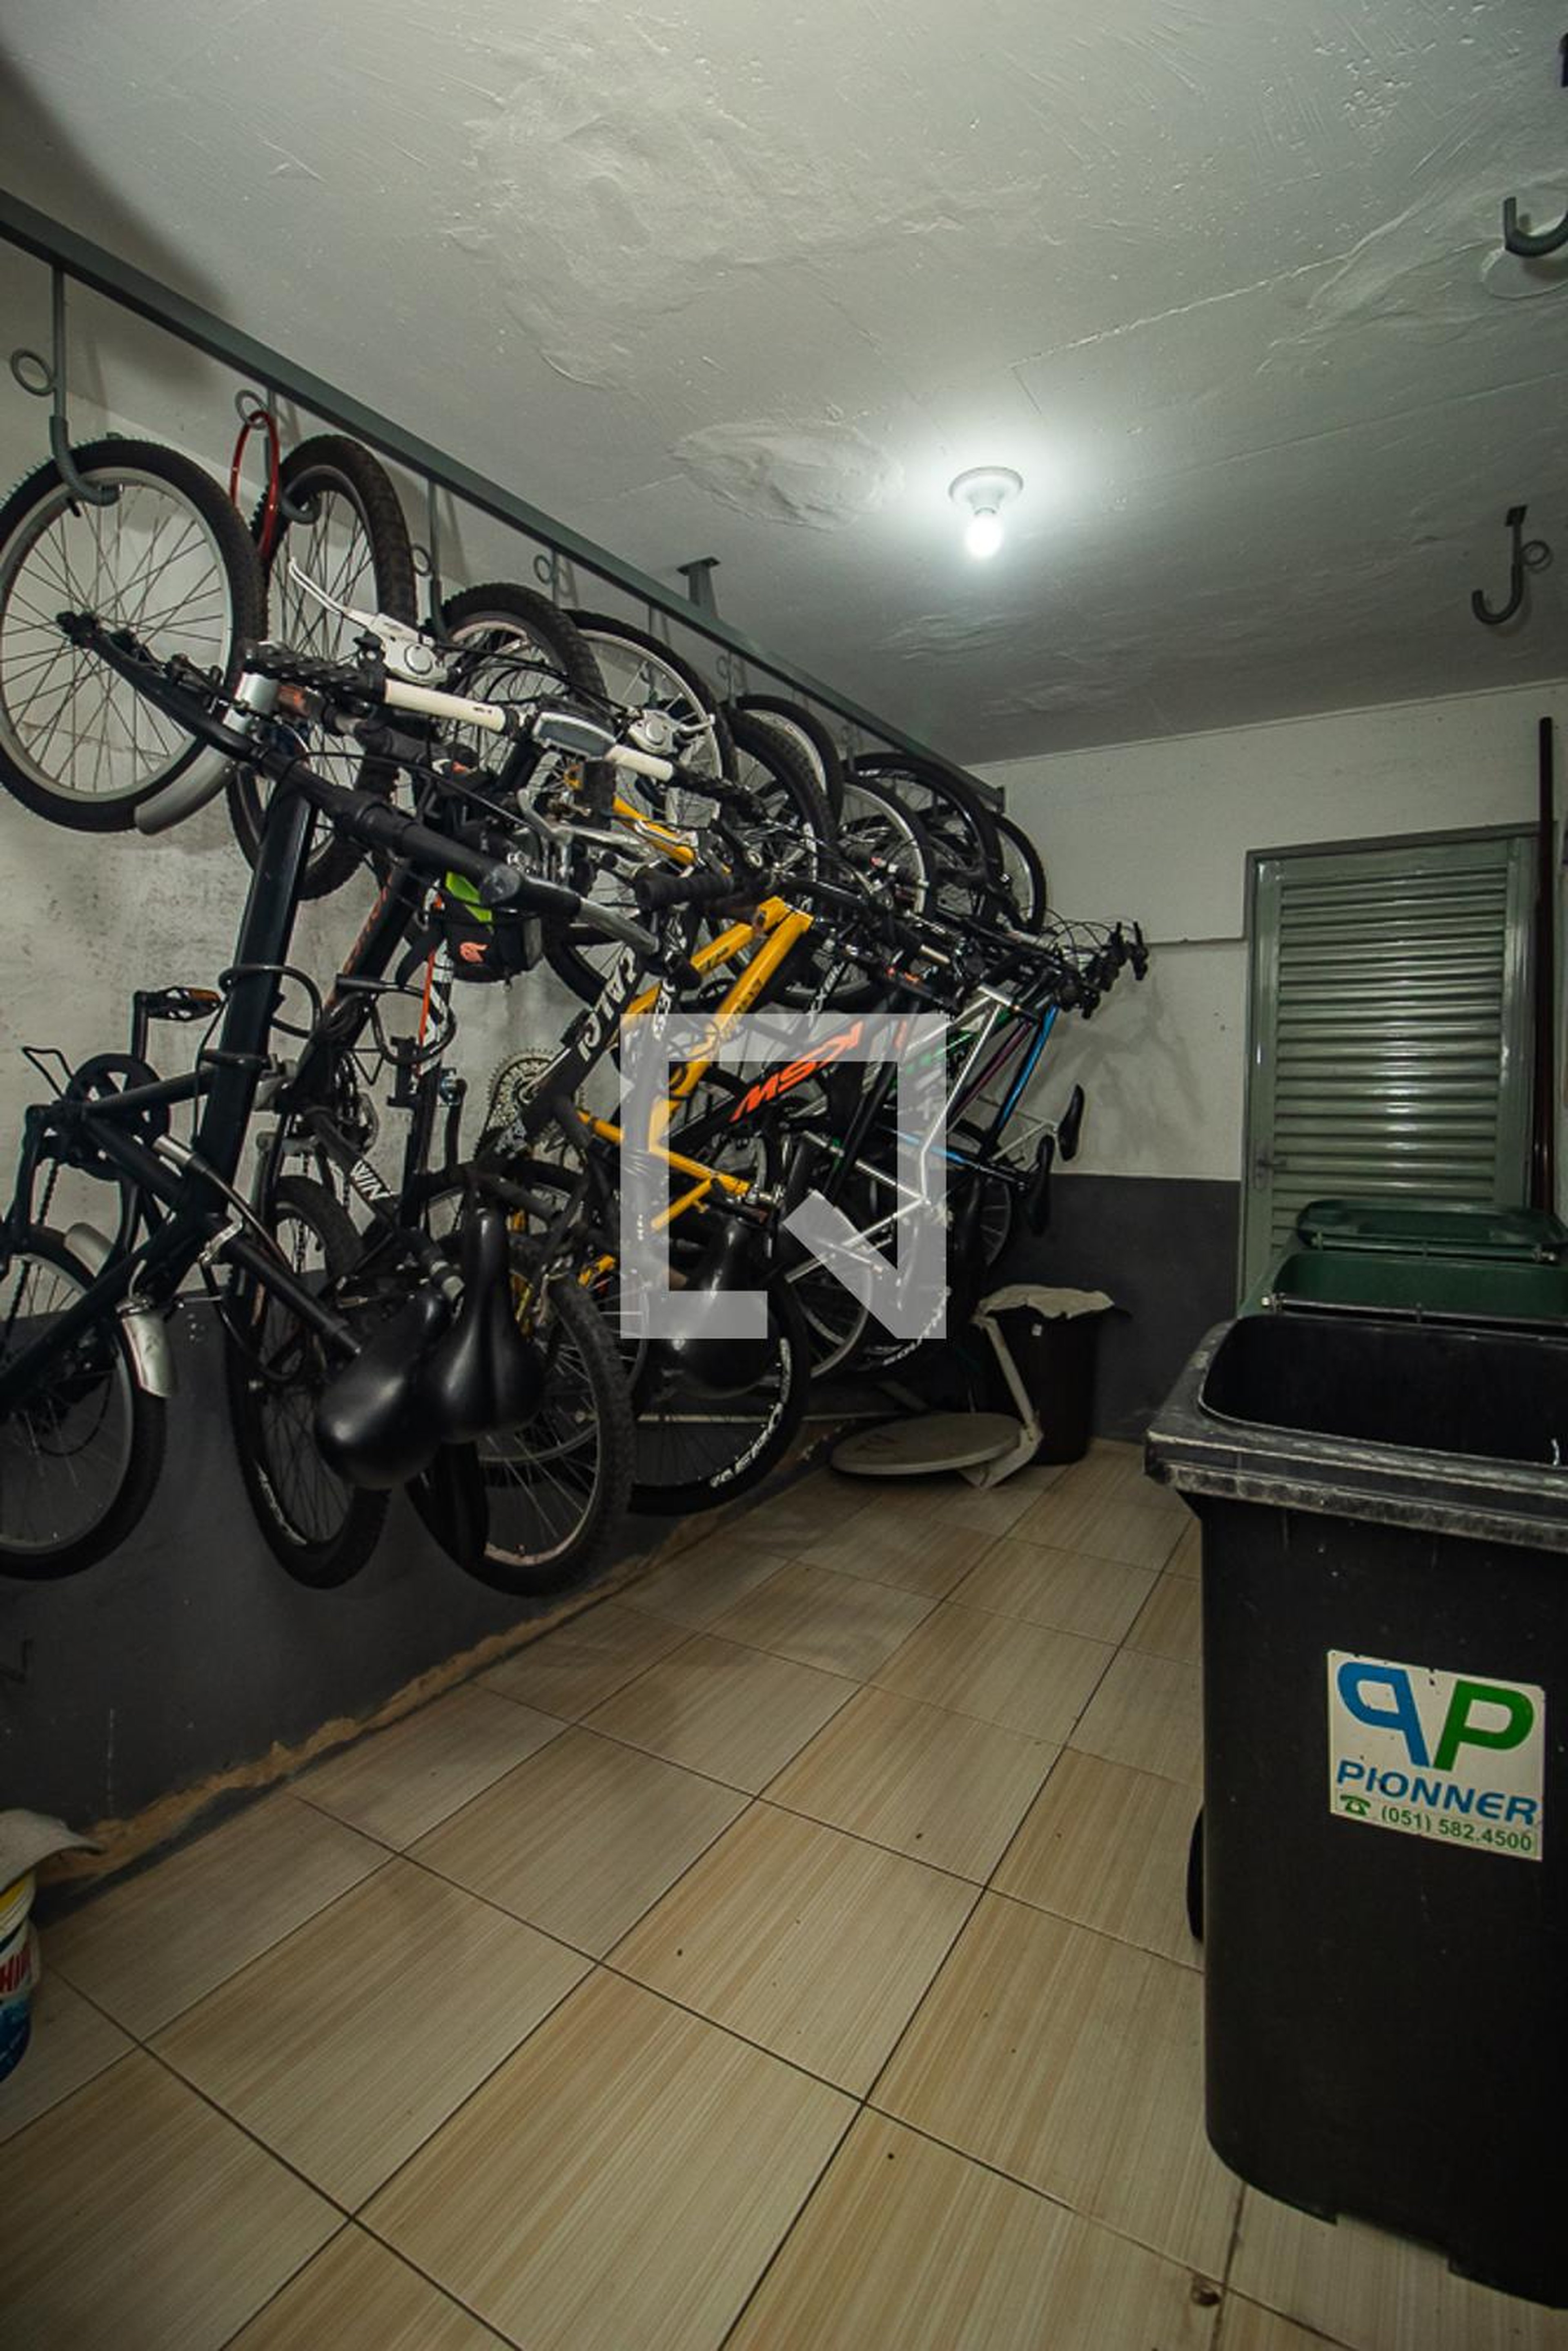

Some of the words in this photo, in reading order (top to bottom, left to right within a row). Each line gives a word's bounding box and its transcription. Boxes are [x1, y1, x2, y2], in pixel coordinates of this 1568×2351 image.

[1337, 1760, 1538, 1826] PIONNER
[1381, 1807, 1432, 1831] (051)
[1439, 1820, 1532, 1851] 582.4500
